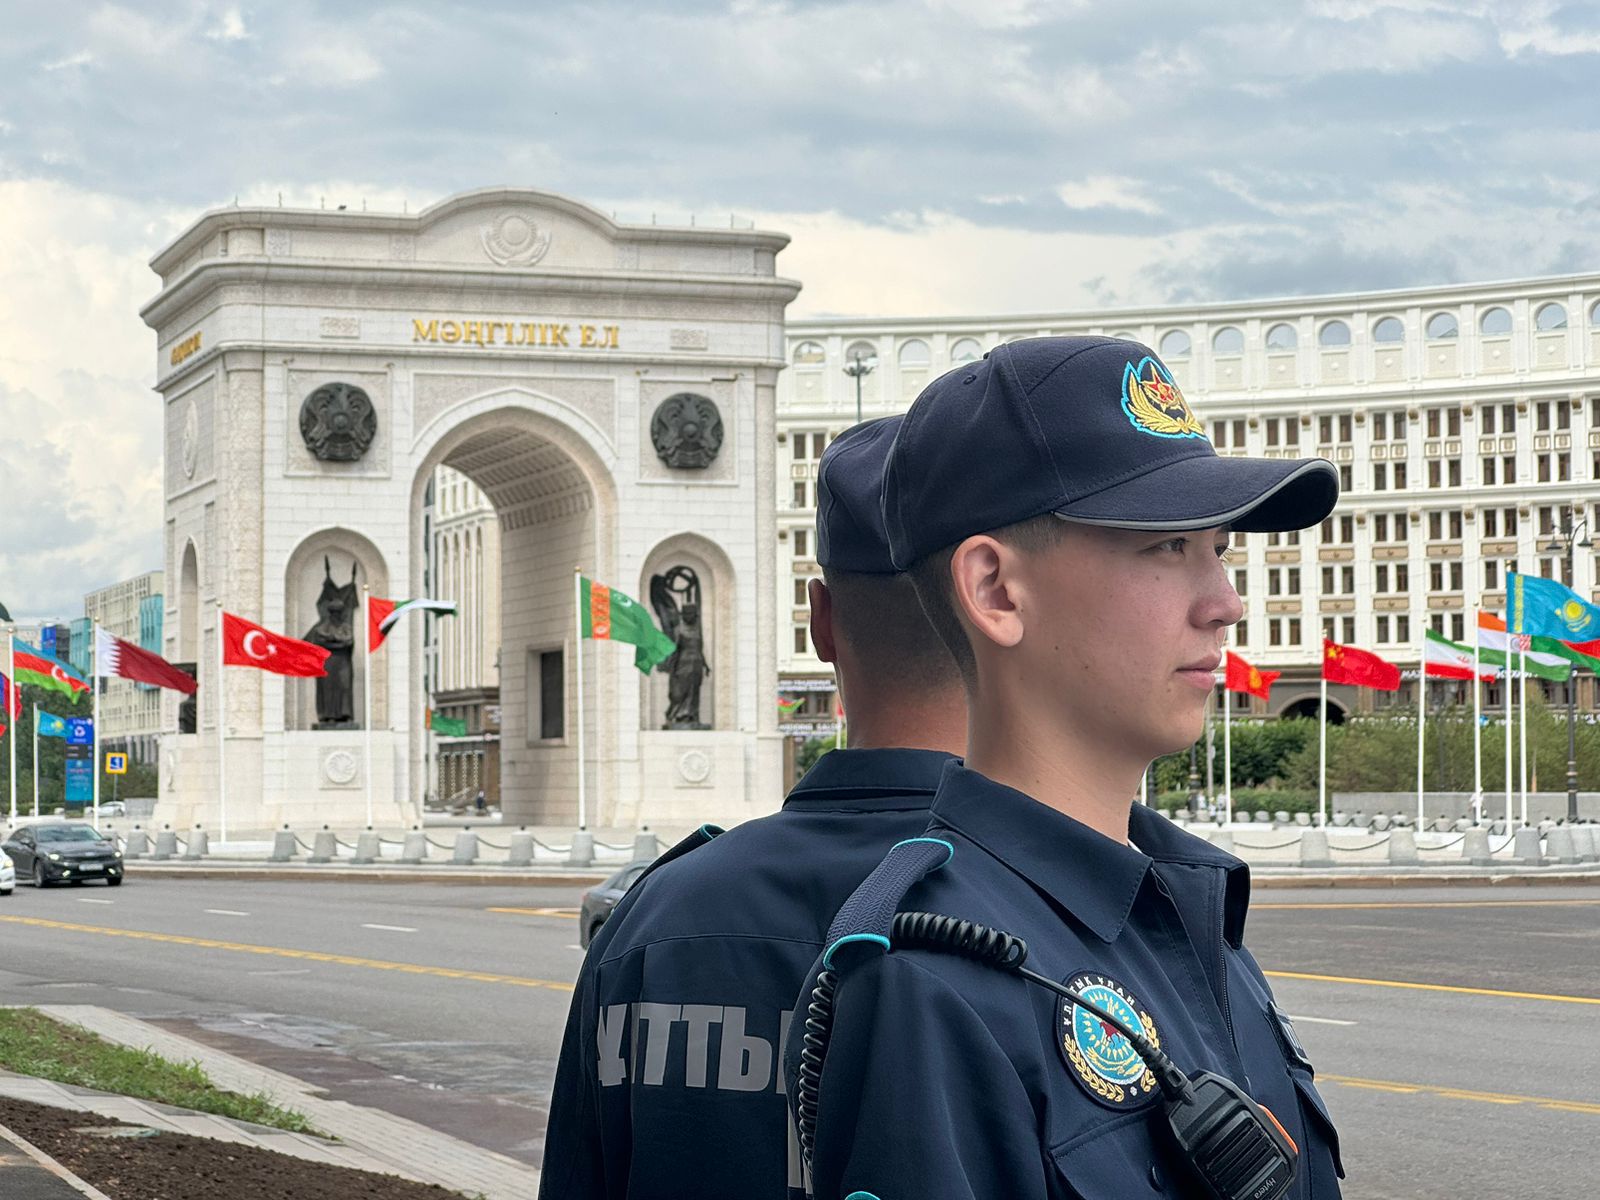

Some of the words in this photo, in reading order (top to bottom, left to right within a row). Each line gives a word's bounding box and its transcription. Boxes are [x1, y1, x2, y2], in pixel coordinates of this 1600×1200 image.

[412, 319, 570, 348] МӘҢГІЛІК
[579, 324, 620, 349] ЕЛ
[1063, 976, 1093, 1026] ҰЛТЫҚ
[1254, 1177, 1277, 1199] Hytera
